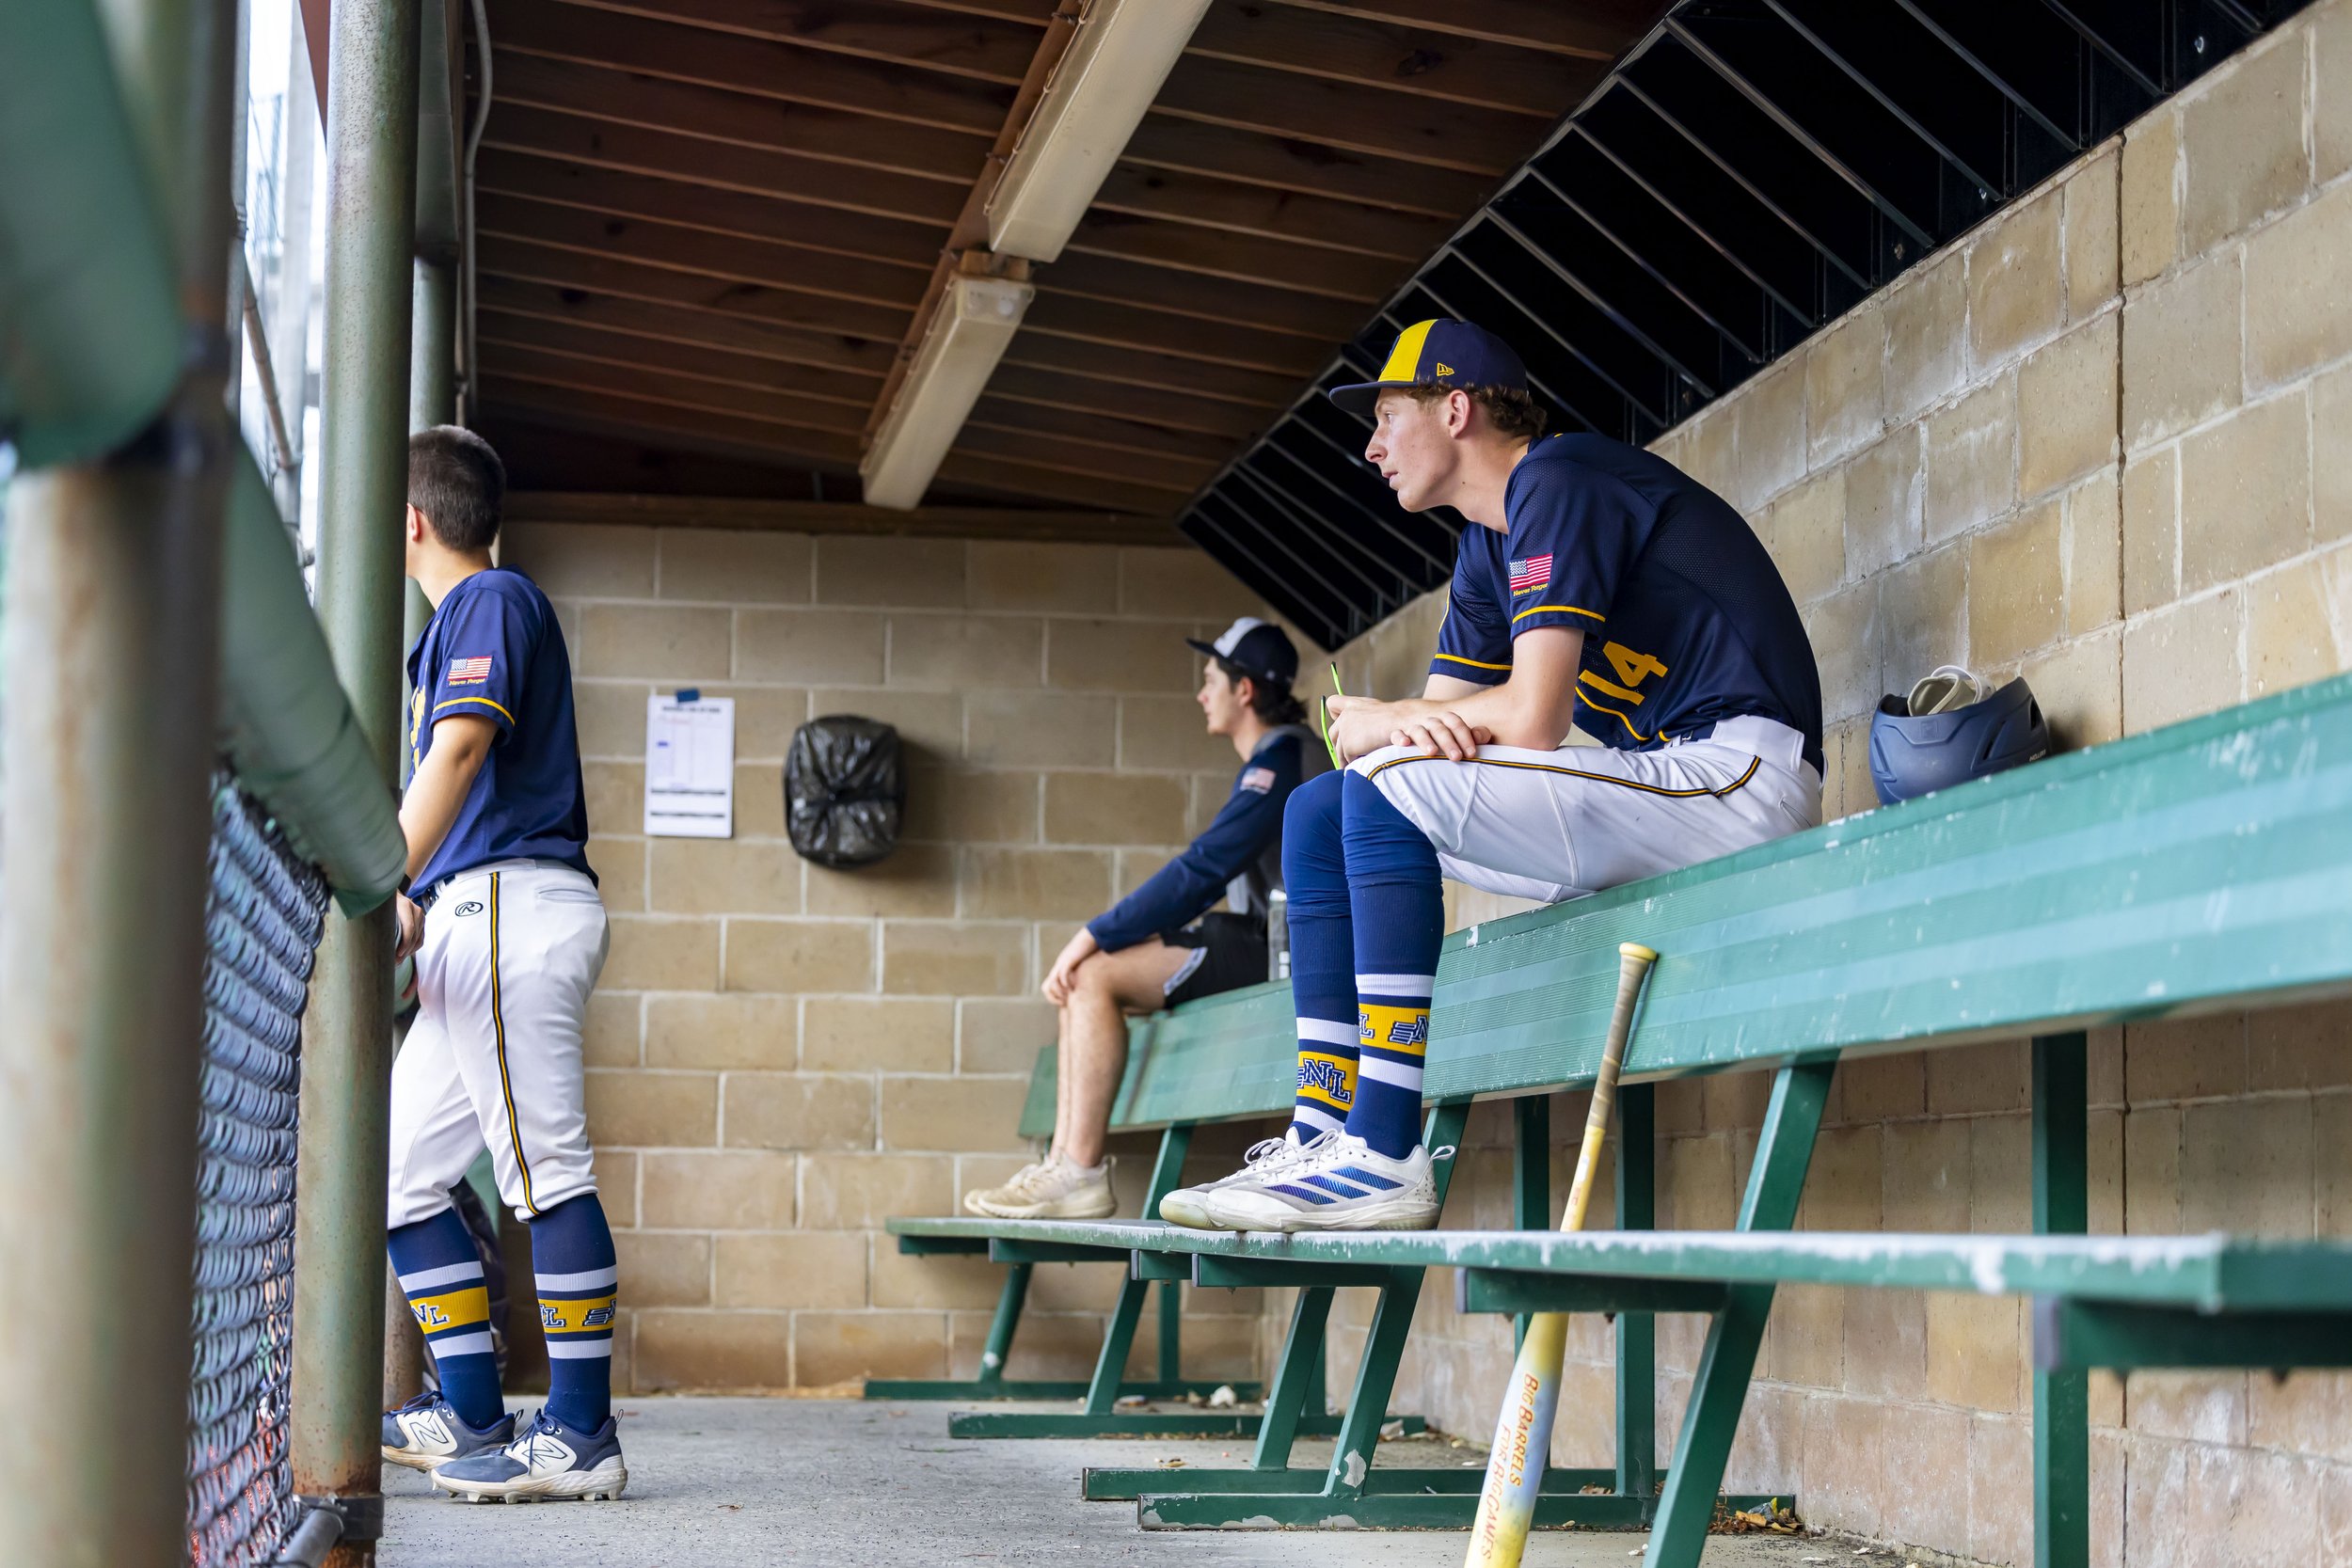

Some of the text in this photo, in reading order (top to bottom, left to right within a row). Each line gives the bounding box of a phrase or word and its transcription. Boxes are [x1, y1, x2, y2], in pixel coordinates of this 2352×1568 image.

[1578, 640, 1669, 706] 14
[1359, 1013, 1375, 1039] L
[539, 1304, 566, 1328] L
